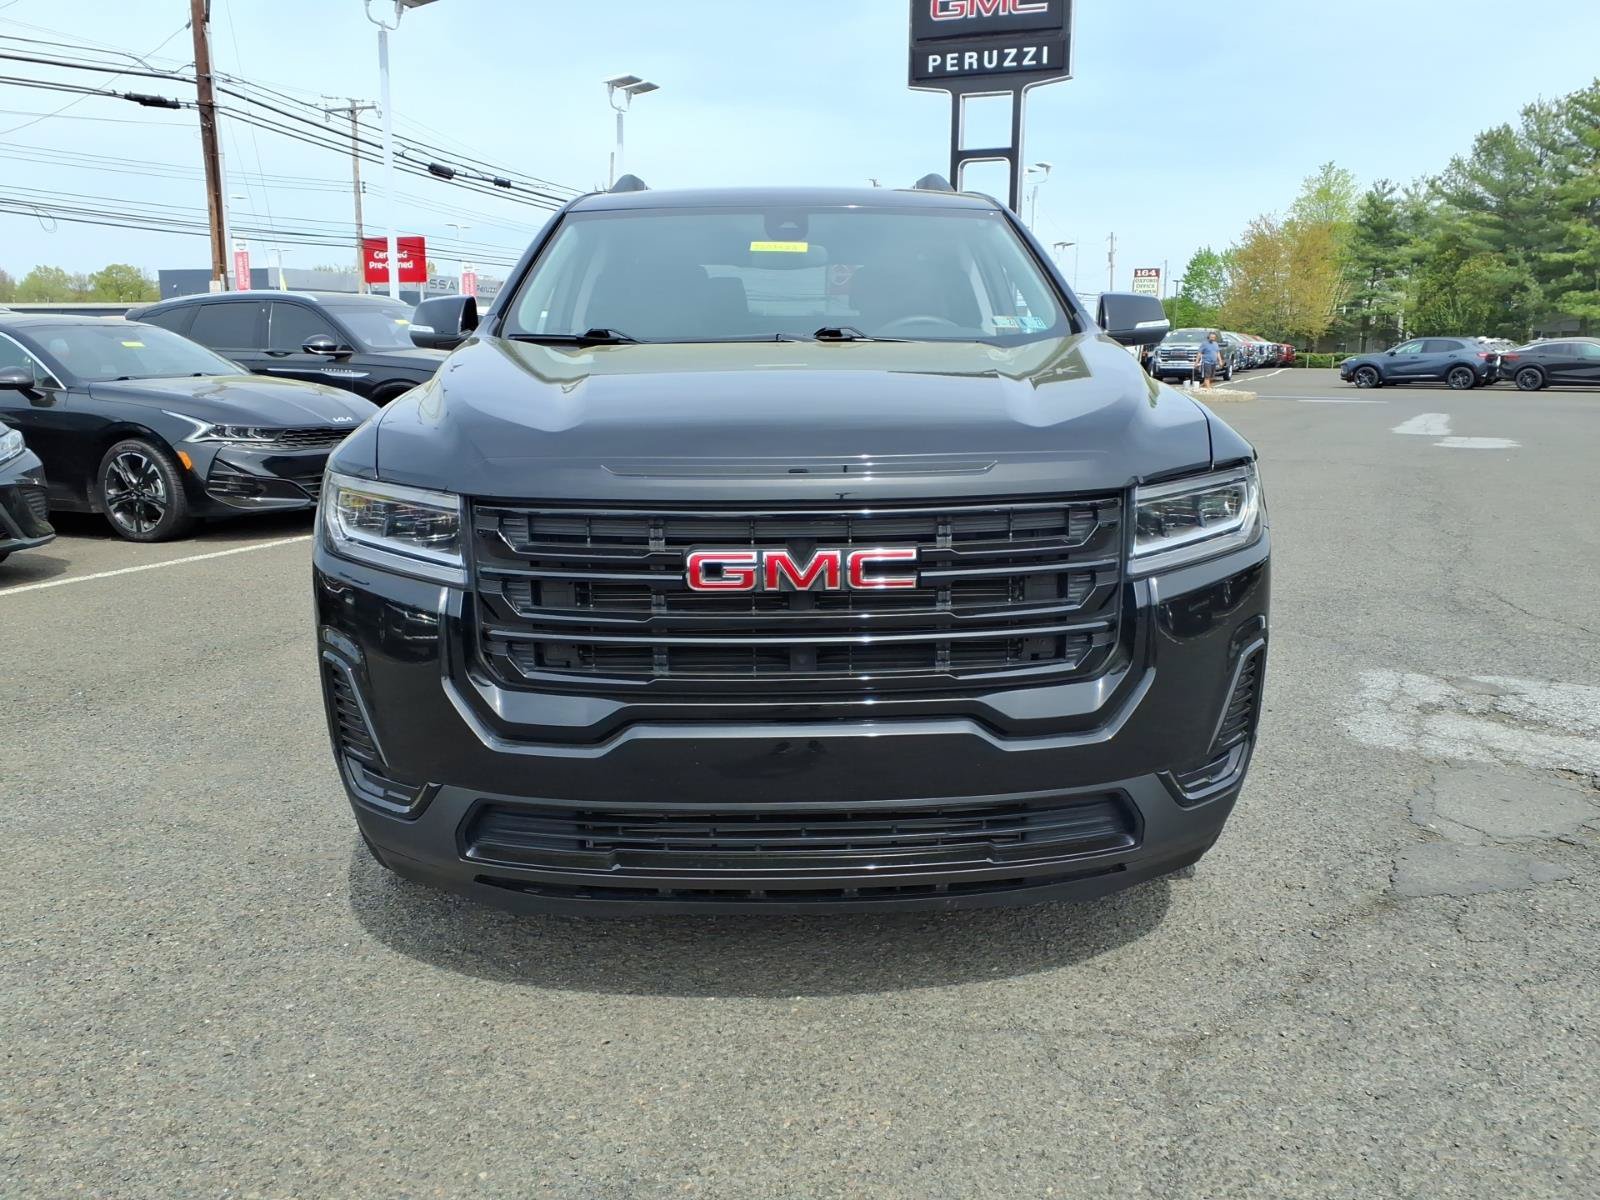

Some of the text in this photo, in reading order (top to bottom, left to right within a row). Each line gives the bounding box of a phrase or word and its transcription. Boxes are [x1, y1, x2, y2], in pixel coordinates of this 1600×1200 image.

[930, 0, 1049, 21] GMC
[928, 46, 1048, 72] PERUZZI
[373, 250, 408, 259] Cered
[368, 260, 414, 269] Pre-Oned
[1136, 269, 1157, 277] 164
[686, 549, 917, 591] GMC
